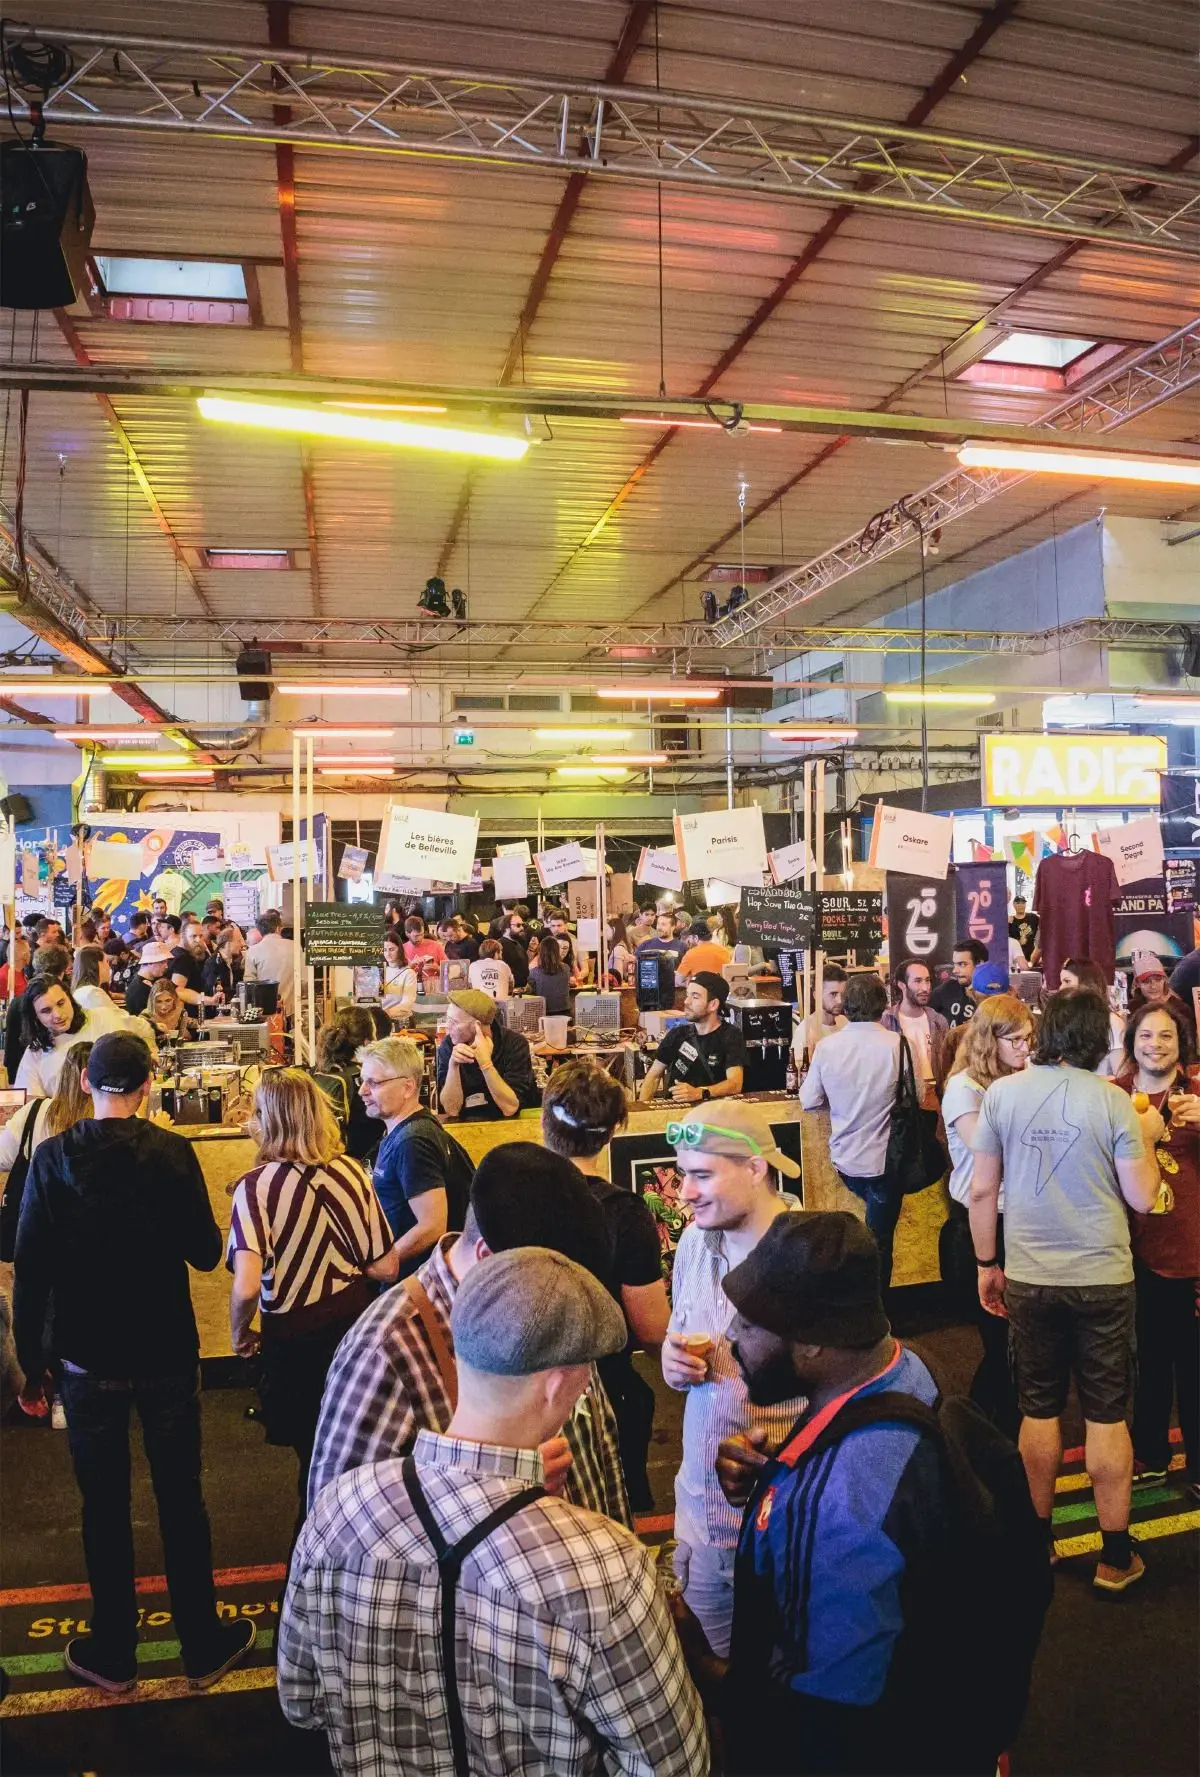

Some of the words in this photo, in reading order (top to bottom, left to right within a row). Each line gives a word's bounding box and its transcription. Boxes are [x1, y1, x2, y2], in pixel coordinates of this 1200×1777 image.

[410, 832, 425, 841] Les
[711, 837, 738, 845] Parisis
[902, 834, 929, 846] Oskare
[404, 841, 416, 849] de
[418, 843, 457, 855] Belleville
[1120, 841, 1144, 853] Second
[747, 896, 762, 911] Hop
[822, 897, 851, 908] SOUR
[481, 972, 499, 980] WAB
[27, 1608, 172, 1638] Stuio
